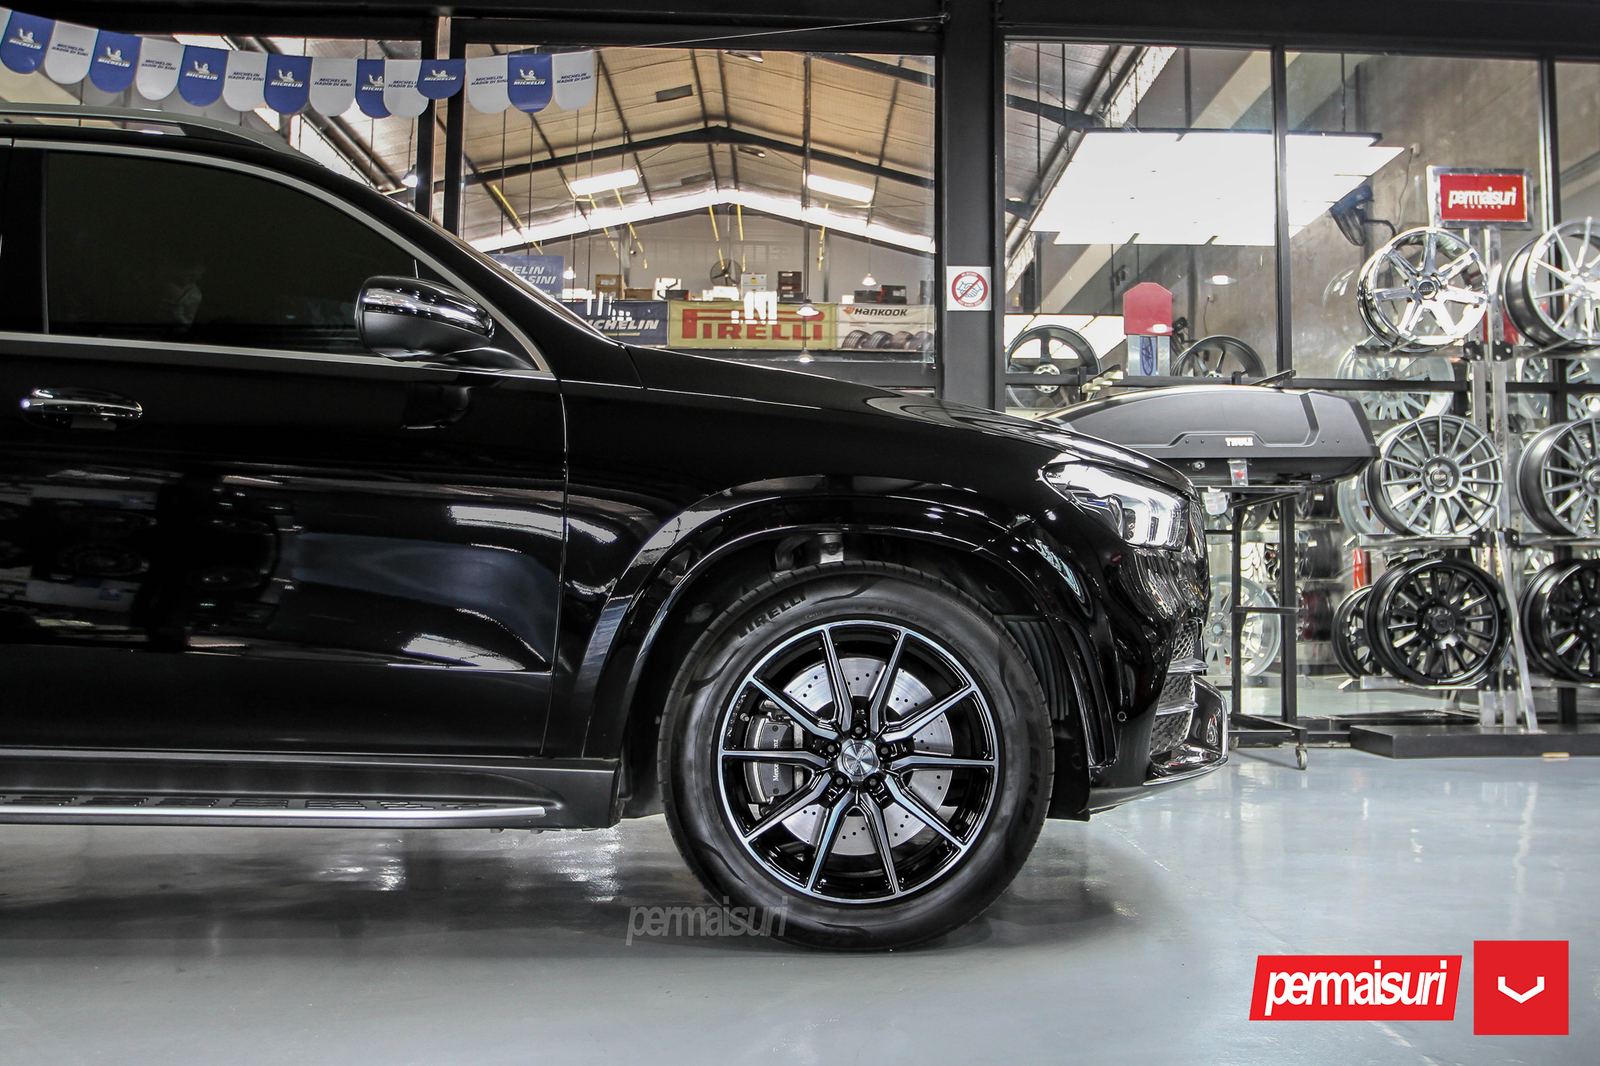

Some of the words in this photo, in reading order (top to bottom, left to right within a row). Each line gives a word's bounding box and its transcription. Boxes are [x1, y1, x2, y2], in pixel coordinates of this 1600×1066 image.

[9, 39, 42, 50] MICHELIN
[97, 58, 131, 68] MICHELIN
[185, 72, 219, 81] MICHELIN
[270, 80, 304, 88] MICHELIN
[1448, 186, 1517, 208] permaisuri
[521, 275, 557, 284] SINI
[585, 319, 660, 330] ICHELIN
[682, 308, 825, 340] PIRELLI
